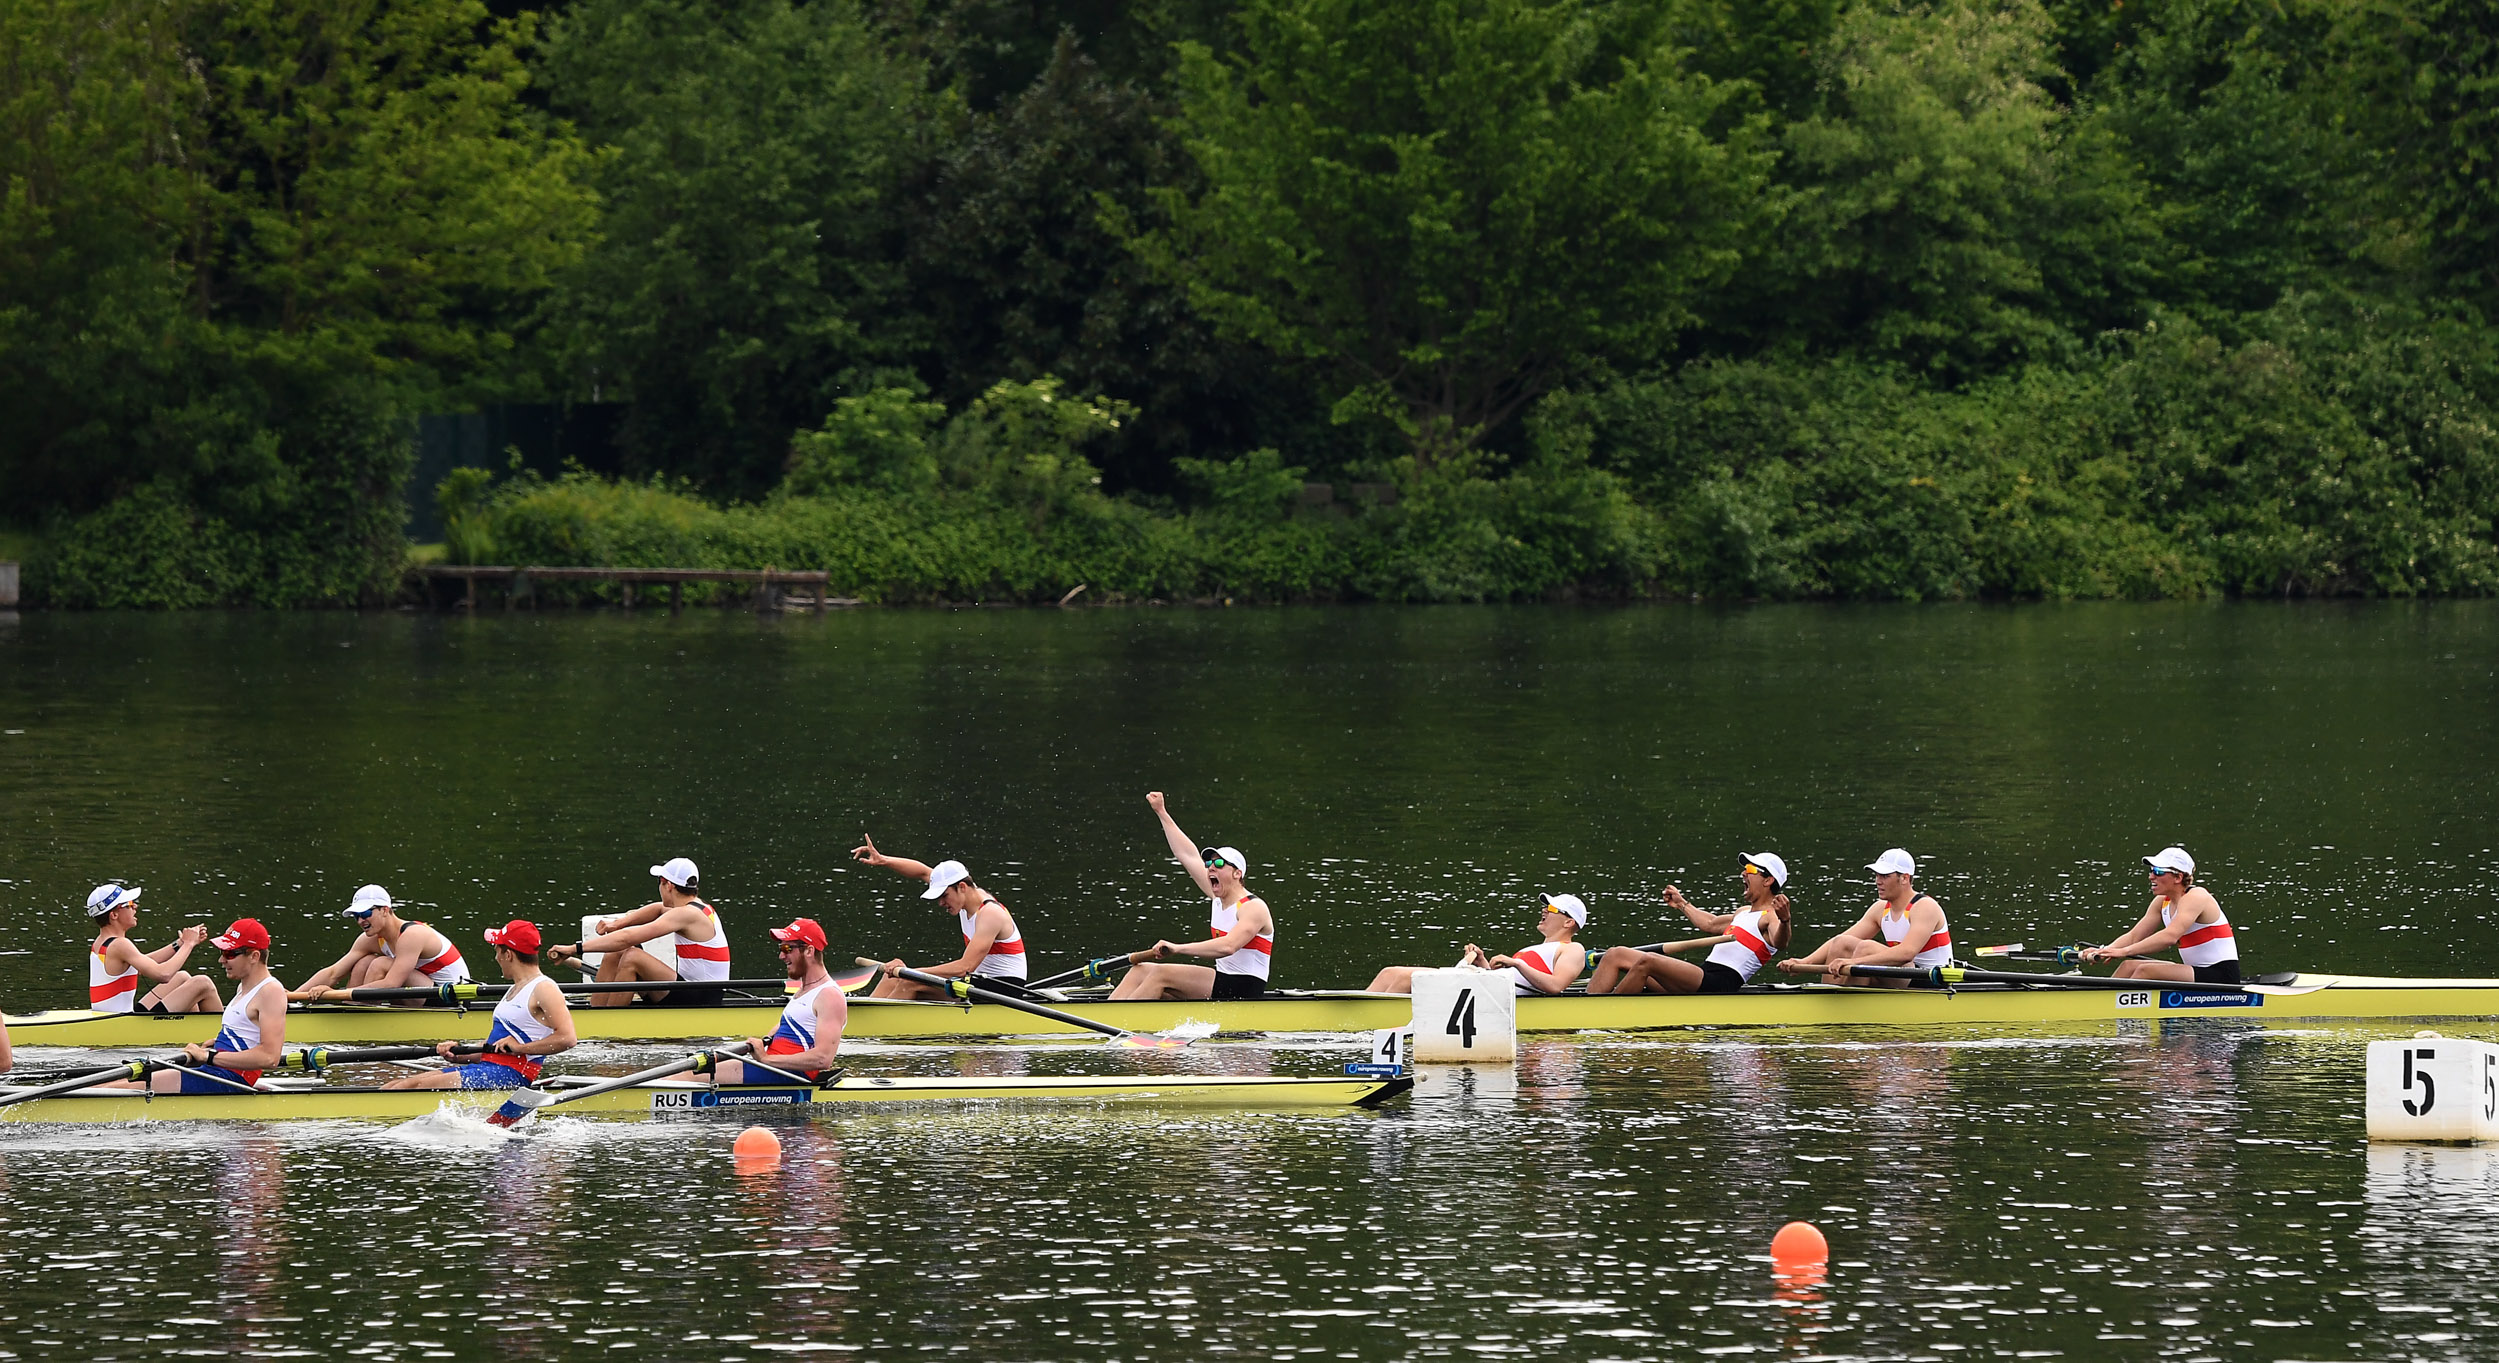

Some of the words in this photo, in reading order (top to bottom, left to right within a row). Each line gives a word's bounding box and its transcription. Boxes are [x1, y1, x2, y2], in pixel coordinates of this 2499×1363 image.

[2118, 993, 2149, 1005] GER
[2184, 995, 2221, 1004] european
[2221, 993, 2248, 1003] rowing
[1446, 988, 1477, 1049] 4
[1381, 1032, 1396, 1063] 4
[2403, 1049, 2435, 1117] 5
[2485, 1053, 2496, 1121] 5
[655, 1094, 688, 1107] RUS
[719, 1095, 761, 1105] european
[761, 1094, 793, 1104] rowing
